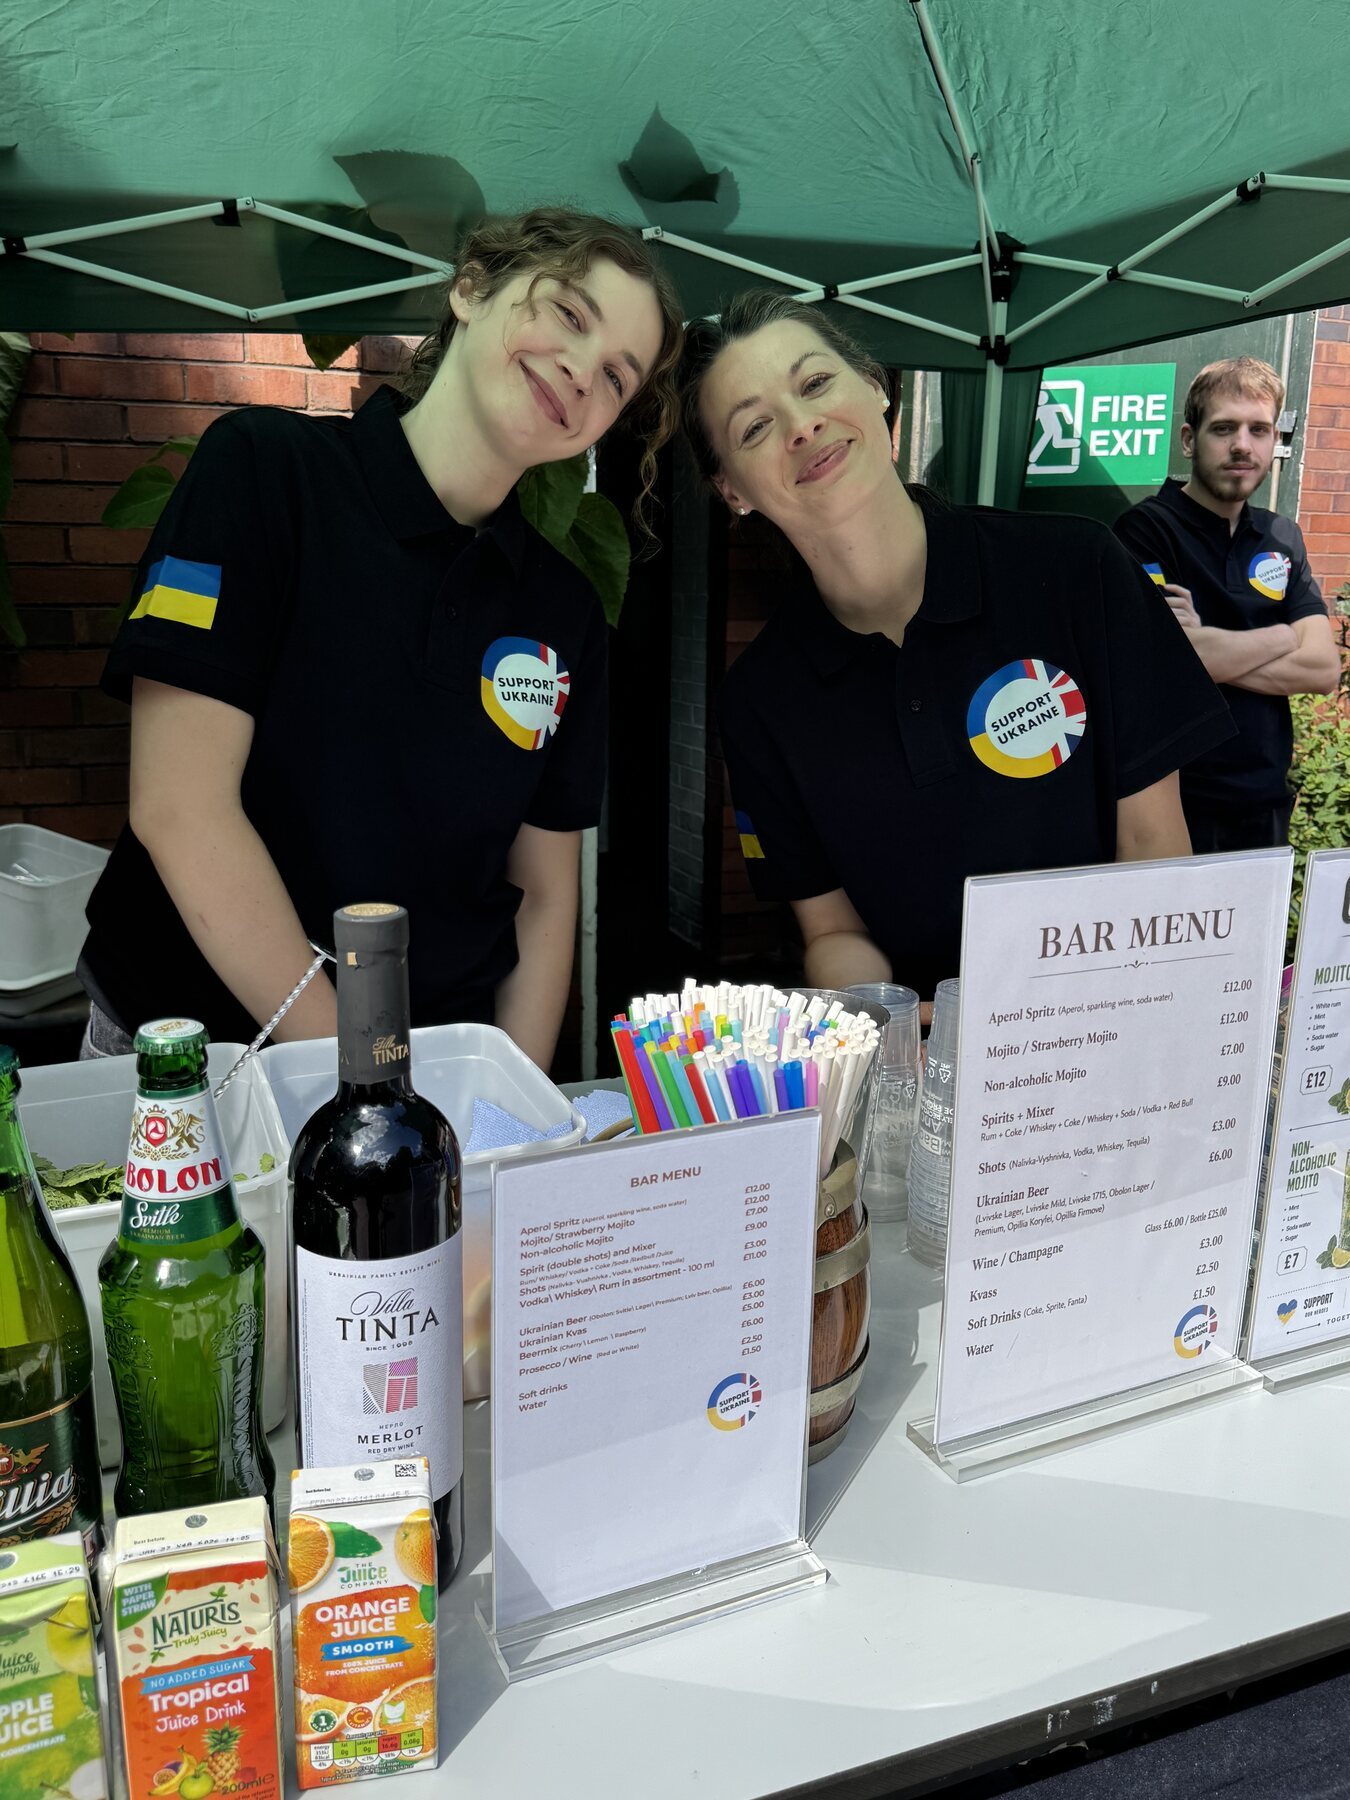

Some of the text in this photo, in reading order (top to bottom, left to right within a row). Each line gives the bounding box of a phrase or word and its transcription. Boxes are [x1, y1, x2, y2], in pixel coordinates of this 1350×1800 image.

[1090, 393, 1167, 423] FIRE
[1089, 428, 1164, 456] EXIT
[1258, 565, 1285, 578] SUPPORT
[498, 677, 554, 691] SUPPORT
[501, 691, 554, 706] UKRAINE
[991, 692, 1052, 732] SUPPORT
[997, 705, 1060, 745] UKRAINE
[1037, 908, 1236, 960] BAR MENU
[1223, 979, 1252, 993] £12.00
[988, 992, 1174, 1027] Aperol Spritz (Aperol, sparkling wine, soda water)
[1219, 1010, 1249, 1025] £12.00
[372, 1044, 410, 1065] TINTA
[986, 1030, 1118, 1061] Mojito Strawberry Mojito
[1220, 1042, 1245, 1057] £7.00
[984, 1067, 1087, 1093] Non-alcoholic Mojito
[1217, 1073, 1242, 1088] £9.00
[1305, 1070, 1327, 1089] £12
[980, 1131, 997, 1142] Rum
[1004, 1127, 1022, 1138] Coke
[1029, 1121, 1056, 1134] Whiskey
[1063, 1118, 1081, 1128] Coke
[1087, 1111, 1114, 1125] Whiskey
[1120, 1108, 1136, 1118] Soda
[1142, 1104, 1162, 1115] Vodka
[1168, 1101, 1180, 1110] Red
[981, 1106, 1055, 1130] Spirits Mixer
[1211, 1117, 1237, 1132] £3.00
[1208, 1148, 1233, 1163] £6.00
[1290, 1140, 1315, 1158] NON-
[978, 1161, 1006, 1175] Shots
[1288, 1151, 1337, 1176] ALCOHOLIC
[126, 1157, 222, 1194] BOLON
[630, 1166, 702, 1188] BAR MENU
[1286, 1172, 1319, 1193] MOJITO
[976, 1186, 1050, 1208] Ukrainian Beer
[1109, 1182, 1150, 1198] Obolon Lager
[129, 1201, 184, 1229] Svitle
[1144, 1206, 1228, 1234] Glass £6.00 Bottle £25.00
[520, 1217, 580, 1236] Aperol Spritz
[520, 1218, 636, 1248] Mojito/ Strawberry Mojito
[520, 1235, 614, 1260] Non-alcoholic Mojito
[1199, 1234, 1224, 1249] £3.00
[520, 1242, 657, 1280] Spirit (double shots) and Mixer
[972, 1243, 1064, 1272] Wine Champagne
[1283, 1252, 1300, 1271] £7
[328, 1271, 367, 1279] UKRAINIAN
[400, 1265, 424, 1275] ESTATE
[1195, 1260, 1219, 1276] £2.50
[519, 1291, 553, 1308] Vodka\
[554, 1284, 597, 1302] Whiskey\
[599, 1281, 620, 1292] Rum
[622, 1278, 630, 1287] in
[632, 1268, 681, 1285] assortment
[687, 1263, 703, 1273] 100
[703, 1260, 715, 1269] ml
[519, 1285, 546, 1297] Shots
[1192, 1285, 1216, 1301] £1.50
[350, 1288, 415, 1317] Villa
[969, 1287, 998, 1302] Kvass
[1303, 1292, 1334, 1310] SUPPORT
[967, 1294, 1088, 1331] Soft Drinks (Coke, Sprite, Fanta)
[336, 1306, 440, 1342] TINTA
[519, 1315, 588, 1337] Ukrainian Beer
[1183, 1321, 1209, 1337] SUPPORT
[519, 1326, 588, 1349] Ukrainian Kvas
[1183, 1327, 1209, 1344] UKRAINE
[519, 1345, 558, 1361] Beermix
[965, 1342, 994, 1358] Water
[519, 1353, 593, 1377] Prosecco Wine
[518, 1382, 568, 1402] Soft drinks
[719, 1389, 750, 1408] SUPPORT
[518, 1399, 548, 1413] Water
[720, 1397, 751, 1414] UKRAINE
[357, 1425, 424, 1444] MERLOT
[397, 1442, 415, 1451] WINE
[337, 1566, 388, 1584] Juice
[340, 1578, 389, 1590] COMPANY
[121, 1592, 155, 1606] PAPER
[122, 1583, 153, 1597] WITH
[120, 1598, 157, 1617] STRAW
[315, 1597, 411, 1623] ORANGE
[152, 1601, 242, 1646] NATURIS
[330, 1615, 397, 1638] JUICE
[172, 1627, 228, 1650] Truly Juicy
[332, 1640, 394, 1656] SMOOTH
[325, 1661, 404, 1677] FROM CONCENTRATE
[364, 1657, 387, 1666] JUICE
[150, 1659, 247, 1689] NO ADDED SUGAR
[148, 1673, 250, 1714] Tropical
[155, 1700, 247, 1733] Juice Drink
[319, 1715, 328, 1727] 1
[354, 1711, 365, 1724] C
